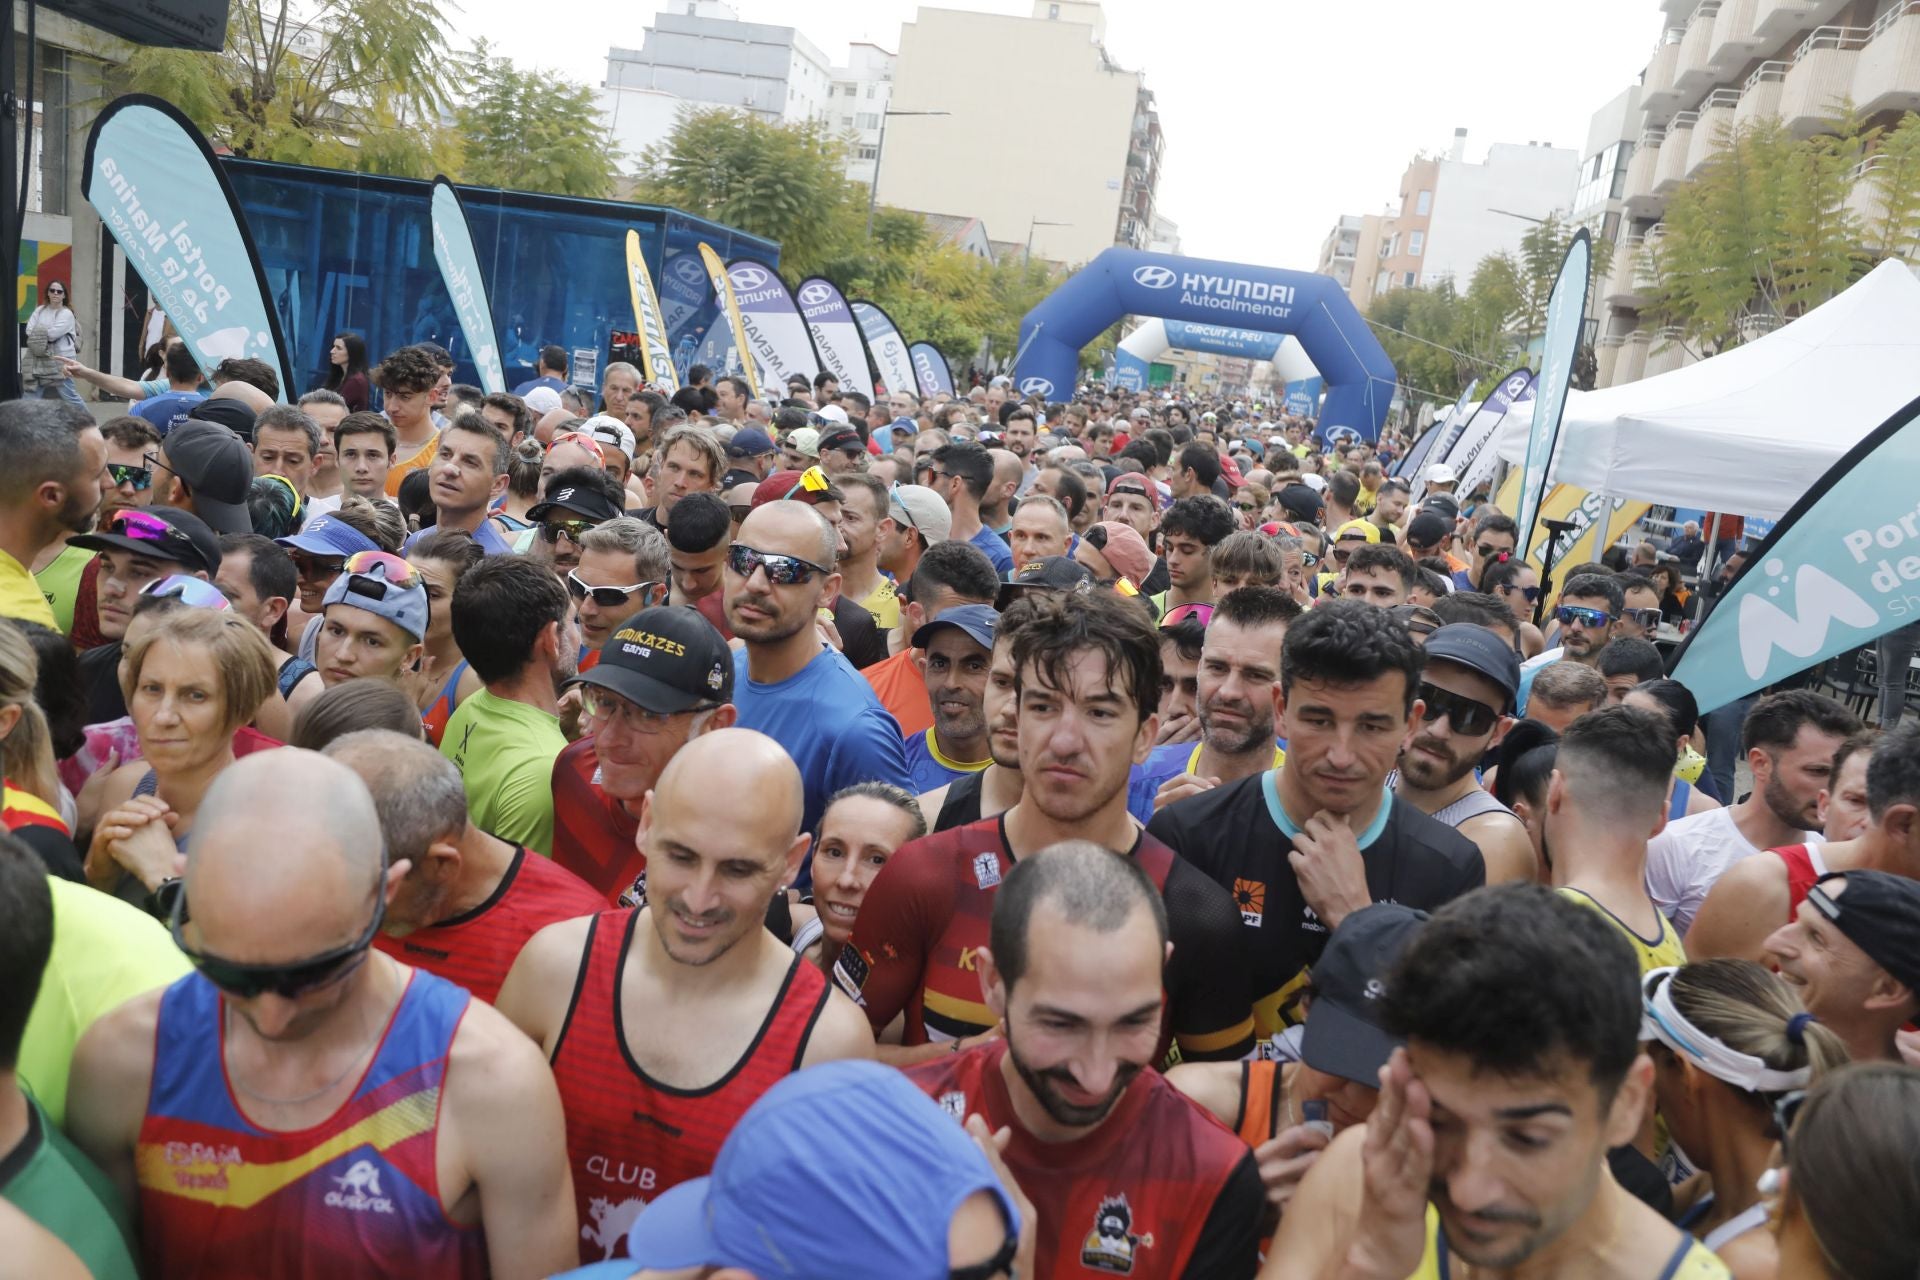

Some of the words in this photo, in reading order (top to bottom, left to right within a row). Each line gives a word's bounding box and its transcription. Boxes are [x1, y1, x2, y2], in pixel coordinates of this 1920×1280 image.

[1180, 291, 1292, 318] Autoalmenar
[1181, 272, 1295, 304] HYUNDAI
[632, 262, 676, 394] asymas
[1184, 324, 1228, 339] CIRCUIT
[1228, 329, 1238, 339] A
[1239, 331, 1264, 342] PEU
[1842, 502, 1920, 564] Por
[1871, 555, 1920, 593] de
[622, 643, 652, 658] GANG
[586, 1155, 656, 1190] CLUB
